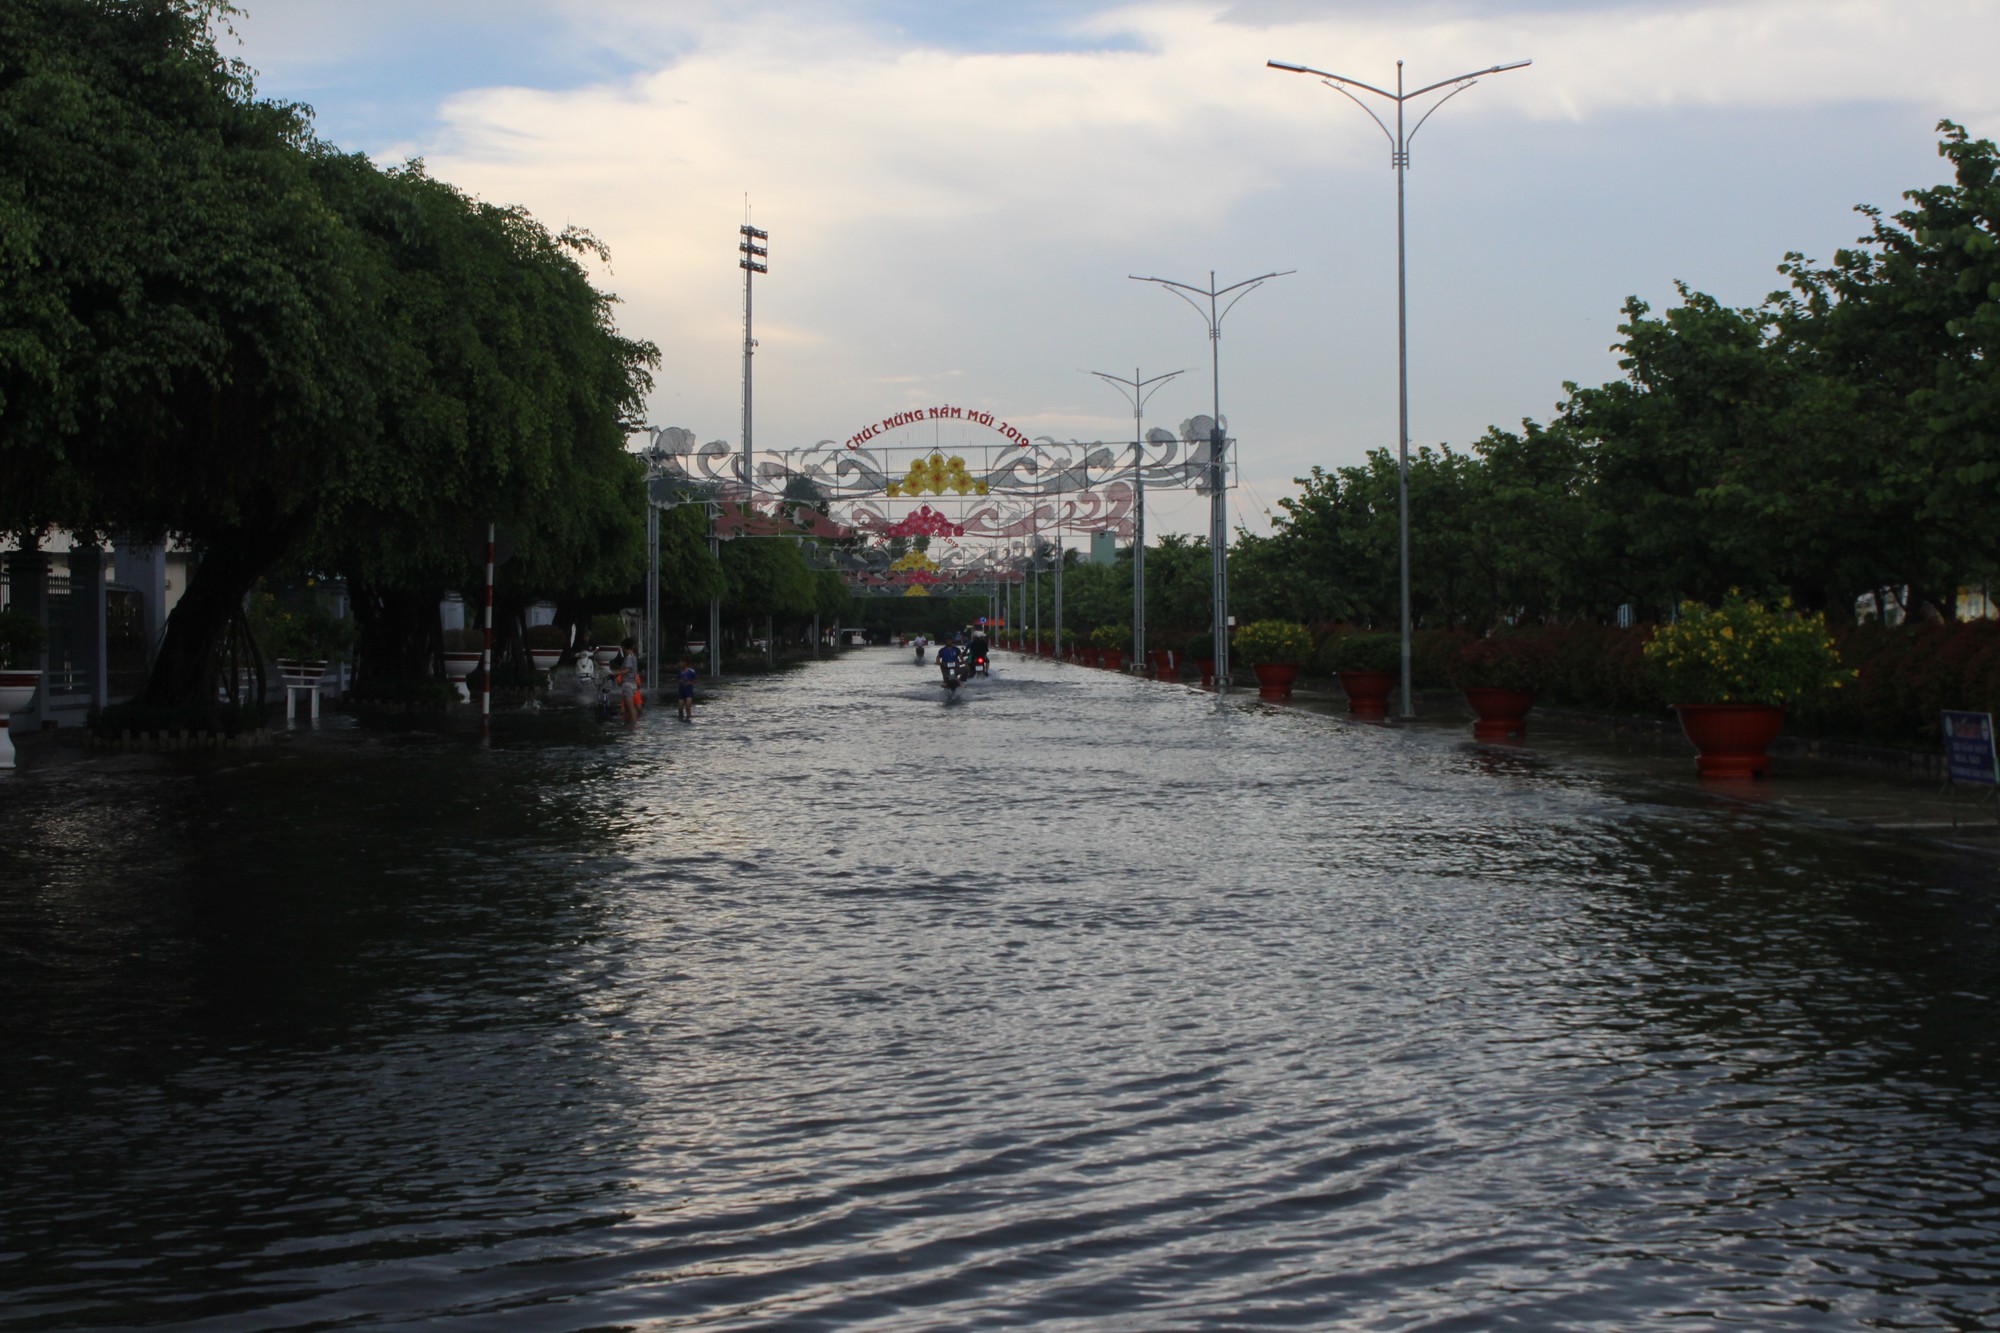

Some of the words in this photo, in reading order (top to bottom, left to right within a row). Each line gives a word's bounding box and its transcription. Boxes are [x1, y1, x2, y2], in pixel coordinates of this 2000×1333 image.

[846, 425, 881, 450] CHÚC
[882, 409, 924, 430] MỪNG
[929, 403, 961, 419] NĂM
[967, 410, 995, 427] MỚI
[998, 422, 1029, 447] 2019
